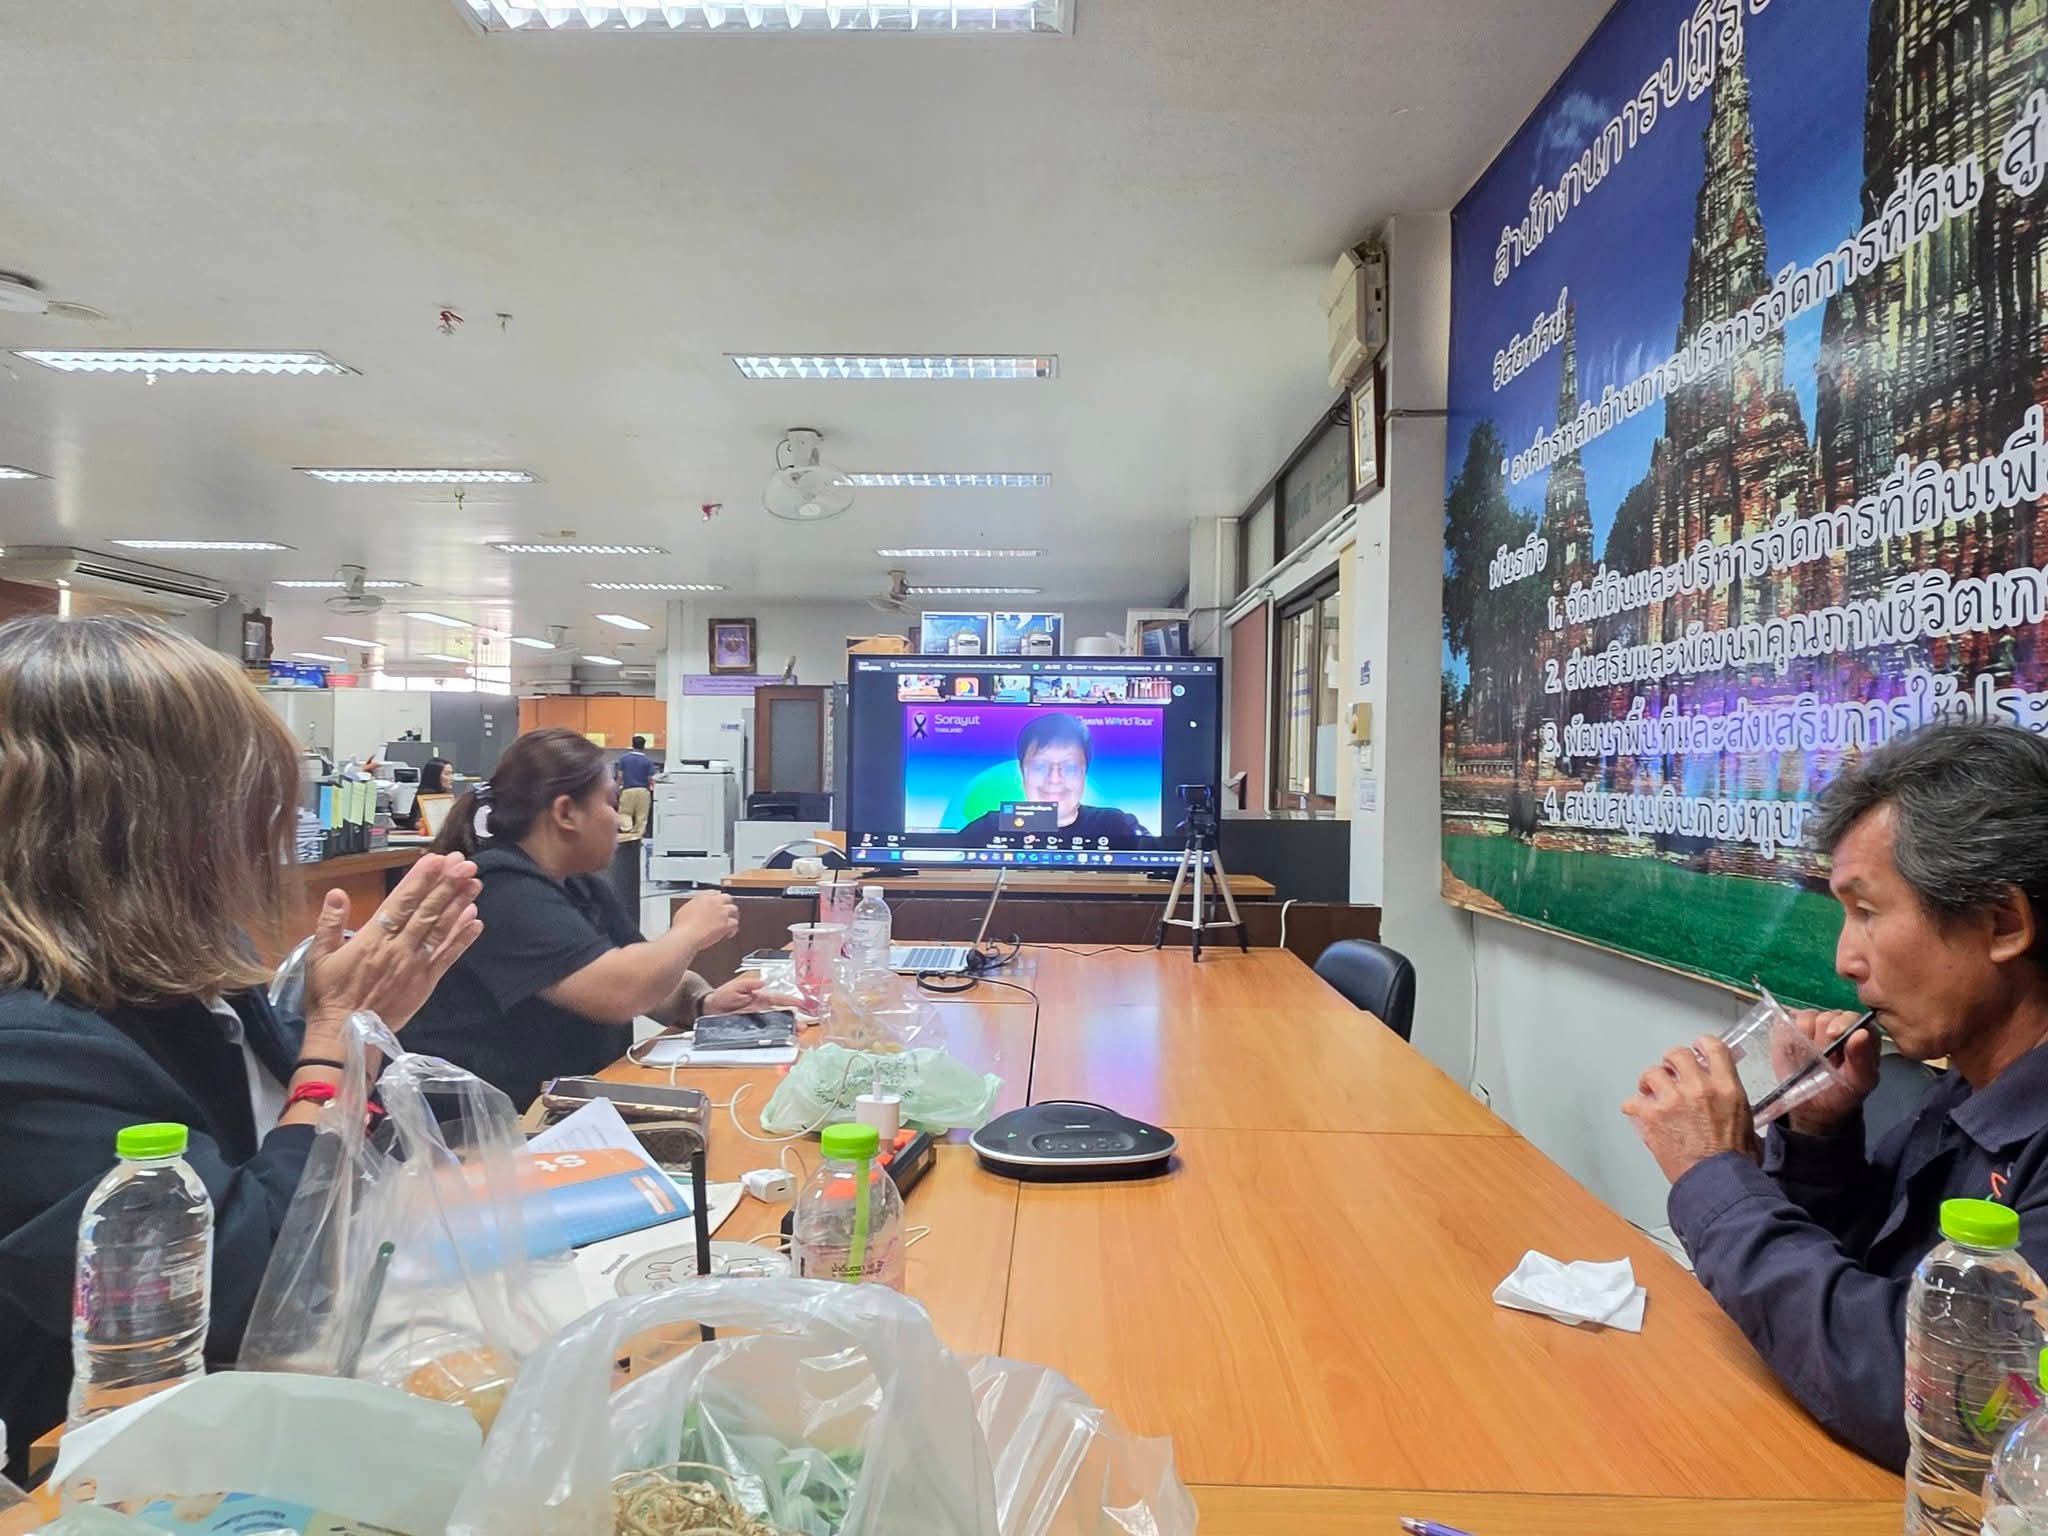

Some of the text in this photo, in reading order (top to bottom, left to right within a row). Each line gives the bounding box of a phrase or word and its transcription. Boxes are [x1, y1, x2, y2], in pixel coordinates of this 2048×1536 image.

[1494, 0, 1770, 285] สำนักงานการปฏิรู
[1493, 286, 1568, 392] วิสัยทัศน์
[1549, 404, 2048, 630] 1. จัดที่ดินและบริหารจัดการที่ดินเพื่
[1489, 532, 1549, 590] พันธกิจ
[934, 713, 980, 726] Sorayut
[1134, 716, 1153, 726] Tour
[1544, 786, 1560, 825] 4.
